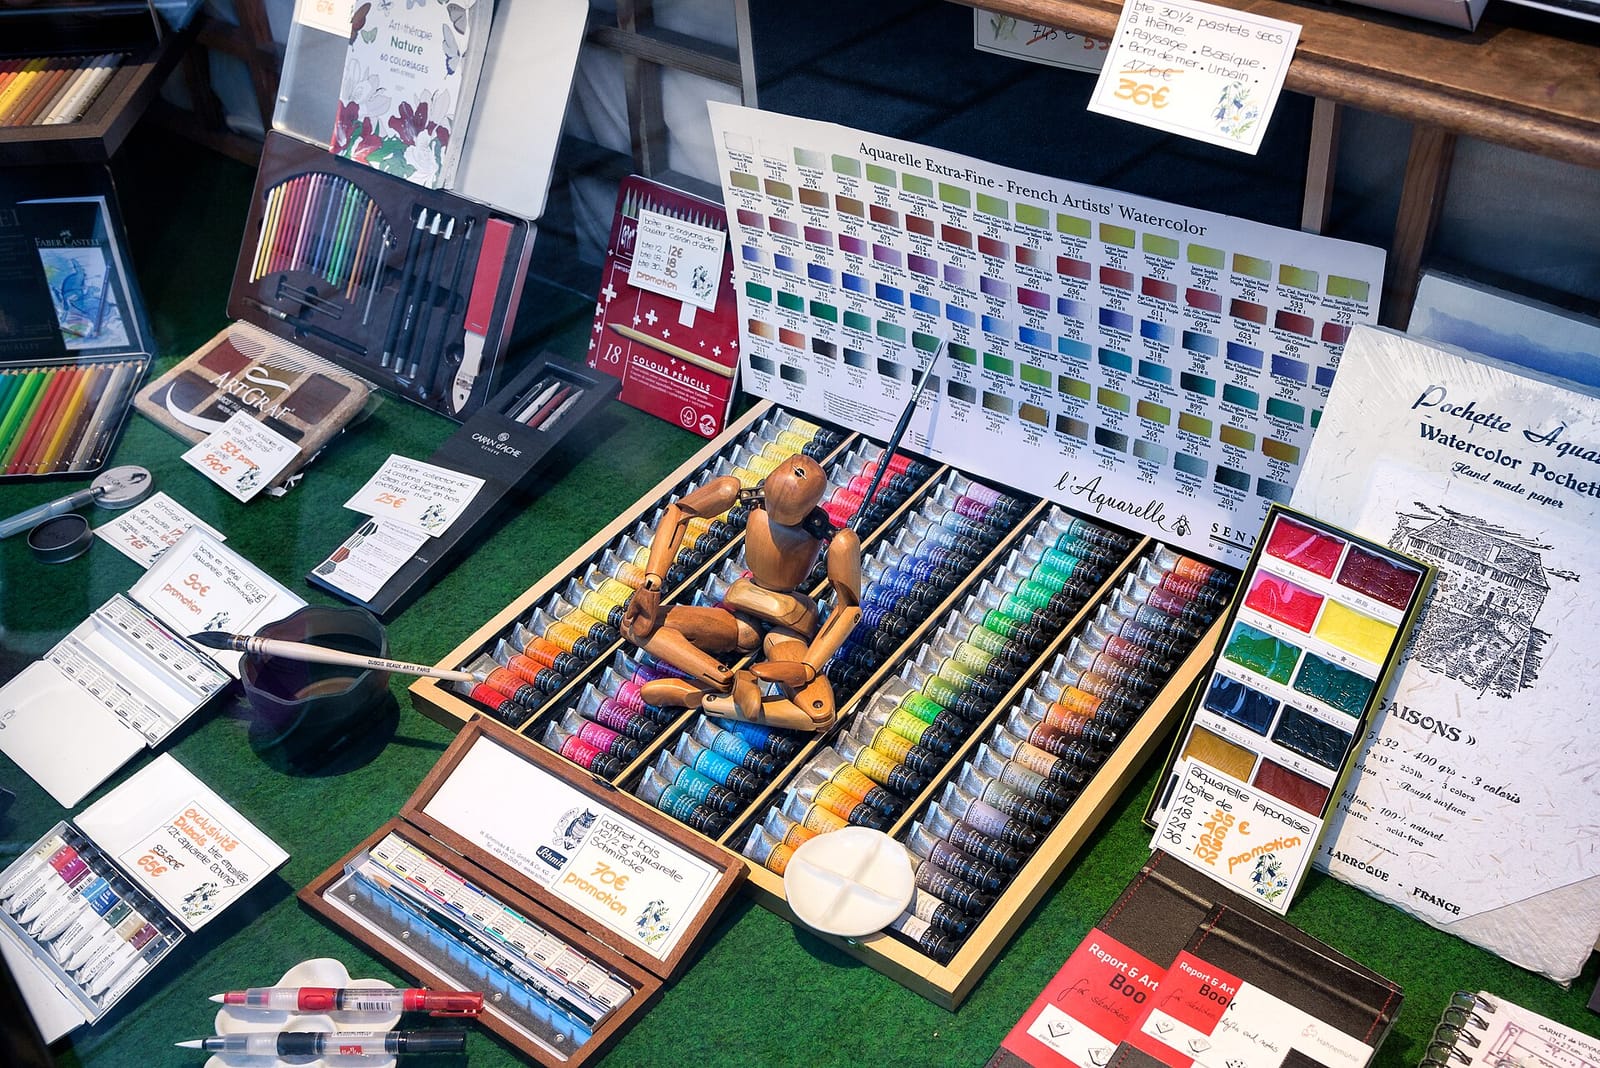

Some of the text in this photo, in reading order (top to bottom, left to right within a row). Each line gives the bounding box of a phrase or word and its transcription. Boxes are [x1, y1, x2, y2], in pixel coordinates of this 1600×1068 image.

[1135, 2, 1155, 13] bte
[1196, 18, 1250, 38] pastels
[390, 35, 424, 56] Nature
[1129, 41, 1156, 56] Bord
[1157, 51, 1174, 62] de
[380, 53, 429, 74] 60 COLORIAGES
[1113, 78, 1170, 109] 36€
[859, 141, 1208, 237] Aquarelle Extra-Fine French Artists' Watercolor
[949, 215, 961, 224] 574
[1027, 236, 1040, 244] 578
[636, 270, 678, 291] promotion
[1337, 311, 1352, 320] 579
[1239, 331, 1252, 340] 623
[602, 342, 622, 365] 18
[632, 354, 669, 375] COLOUR
[672, 370, 712, 392] PENCILS
[208, 371, 291, 420] ARTGRAF
[1411, 384, 1512, 433] Pochette
[1231, 415, 1244, 424] 807
[1228, 456, 1240, 464] 252
[1419, 422, 1522, 469] Watercolor
[1271, 470, 1284, 478] 257
[1450, 461, 1565, 509] Hand made paper
[374, 492, 407, 509] 25€
[1053, 470, 1178, 533] l'Aquarelle
[160, 583, 202, 616] promotion
[183, 573, 211, 597] 90€
[402, 663, 415, 671] ARTS
[1382, 737, 1399, 751] 32
[1413, 752, 1438, 767] 400
[1471, 775, 1483, 786] 3
[1185, 778, 1233, 813] boîte de
[1191, 766, 1311, 835] aquarelle japonaise
[1433, 797, 1467, 817] surface
[1441, 782, 1448, 790] 3
[1449, 787, 1476, 802] colors
[1168, 816, 1187, 833] 24
[1173, 806, 1193, 820] 18
[1178, 794, 1251, 836] 12 35 €
[184, 808, 240, 852] exclusivité
[601, 819, 660, 859] coffret bois
[1385, 826, 1424, 847] acid-free
[178, 837, 211, 865] aquarelle
[589, 836, 645, 874] Schmincke
[1162, 830, 1219, 866] 36 102
[1228, 835, 1302, 875] promotion
[137, 855, 168, 878] 65€
[589, 861, 630, 892] 70€
[631, 848, 684, 883] aquarelle
[1326, 846, 1461, 916] LARROQUE FRANCE
[563, 871, 628, 917] promotion
[1088, 942, 1161, 992] Report & Art
[1179, 961, 1236, 995] Report & Art
[1198, 983, 1237, 1011] Book
[1538, 1024, 1567, 1040] CARNET
